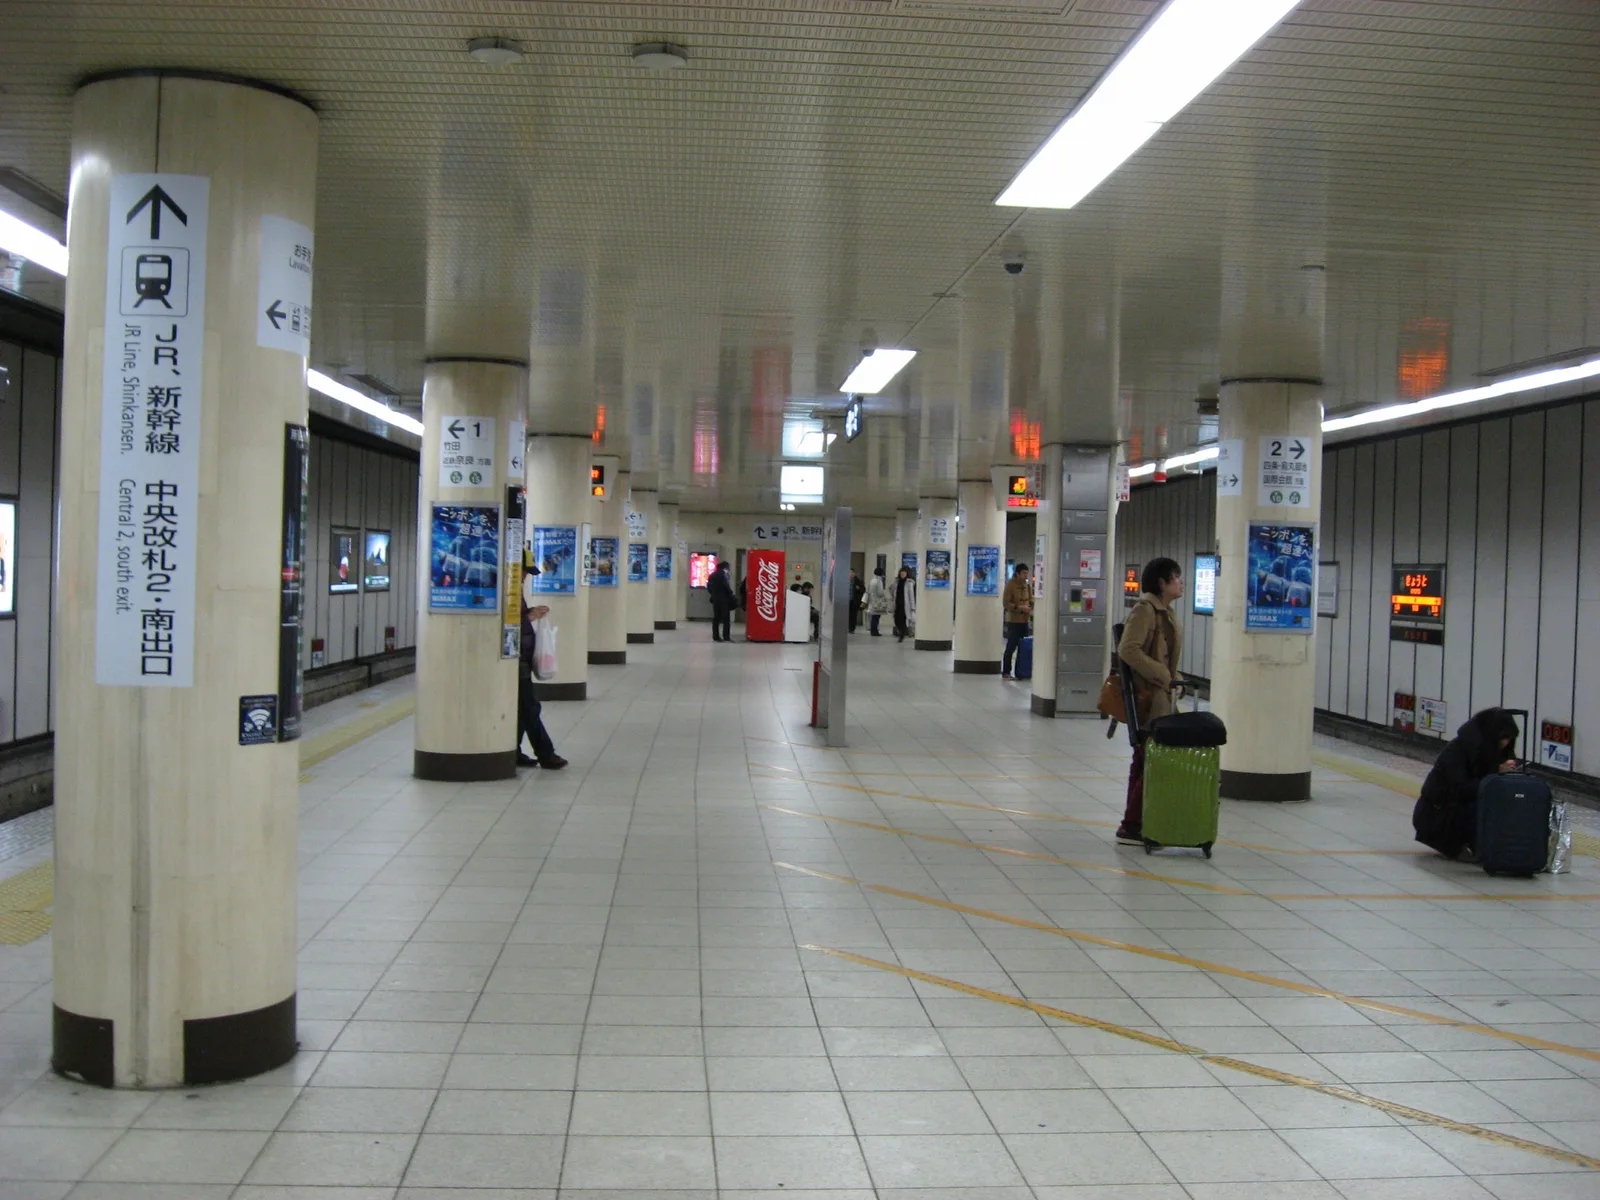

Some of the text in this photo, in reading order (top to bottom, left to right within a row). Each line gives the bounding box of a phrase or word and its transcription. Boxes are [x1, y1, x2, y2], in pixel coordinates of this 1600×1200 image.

[125, 323, 142, 337] JR
[121, 340, 141, 372] Line,
[472, 422, 481, 438] 1
[1271, 441, 1282, 456] 2
[117, 478, 137, 526] Central
[140, 324, 182, 677] JR、新幹線 中央改札2・南出口
[115, 531, 135, 541] 2,
[116, 546, 135, 583] south
[115, 587, 134, 615] exit.
[757, 558, 779, 622] Coca-Cola
